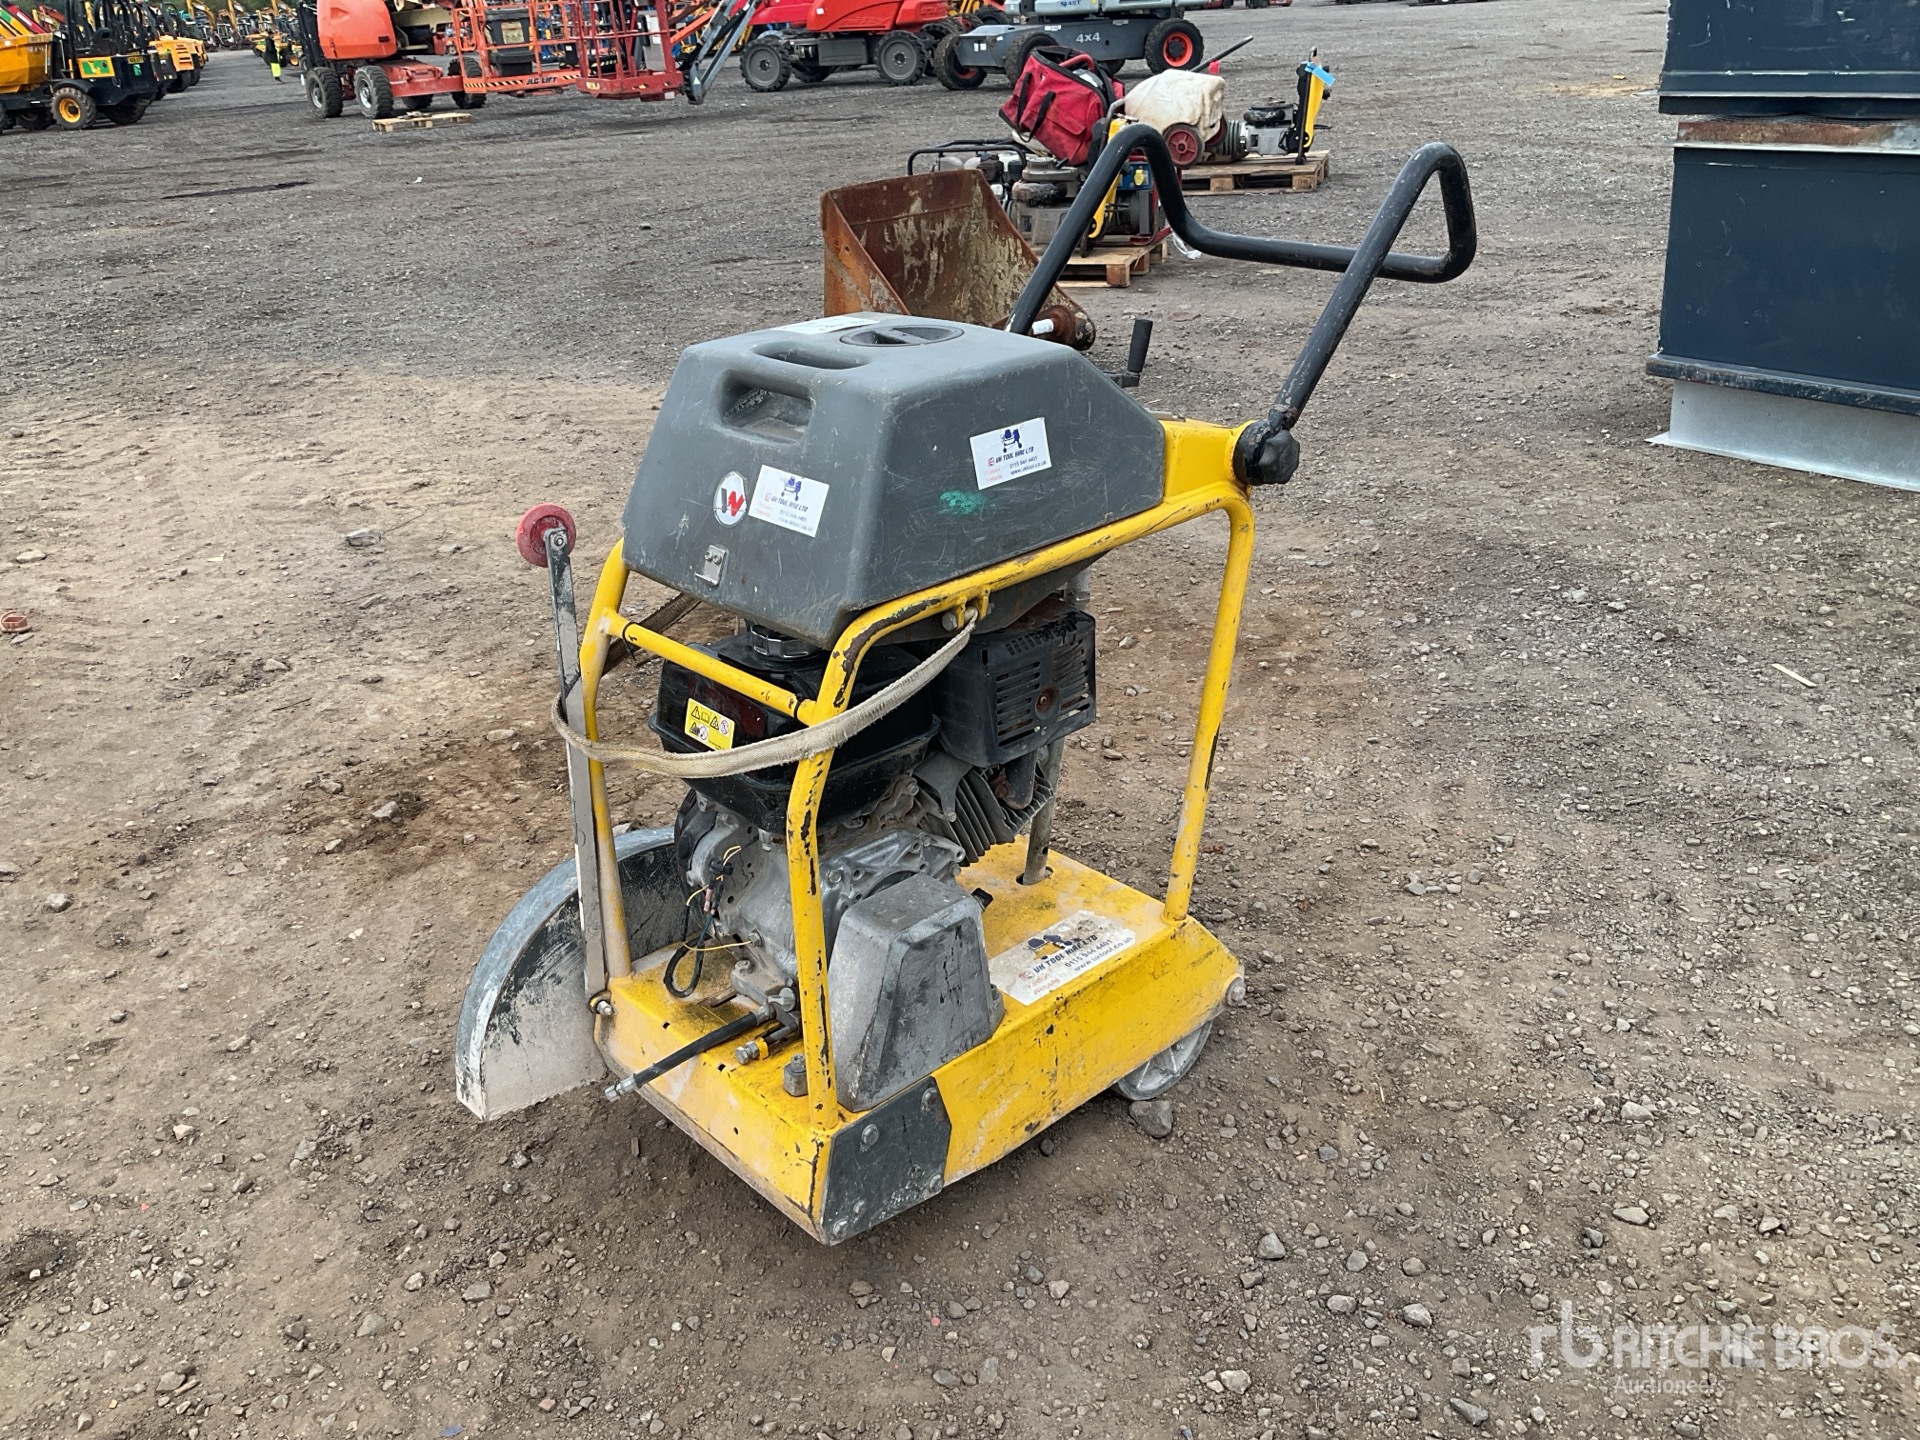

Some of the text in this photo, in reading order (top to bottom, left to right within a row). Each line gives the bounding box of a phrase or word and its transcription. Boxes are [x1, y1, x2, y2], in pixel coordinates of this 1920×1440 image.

[1076, 32, 1101, 43] 4x4
[542, 76, 558, 84] LIFT
[1003, 453, 1014, 461] TOOL
[1026, 446, 1034, 454] LTD
[1033, 934, 1098, 973] UK TOOL HIRE LTD
[1064, 956, 1083, 968] 0115
[1082, 949, 1097, 958] 944
